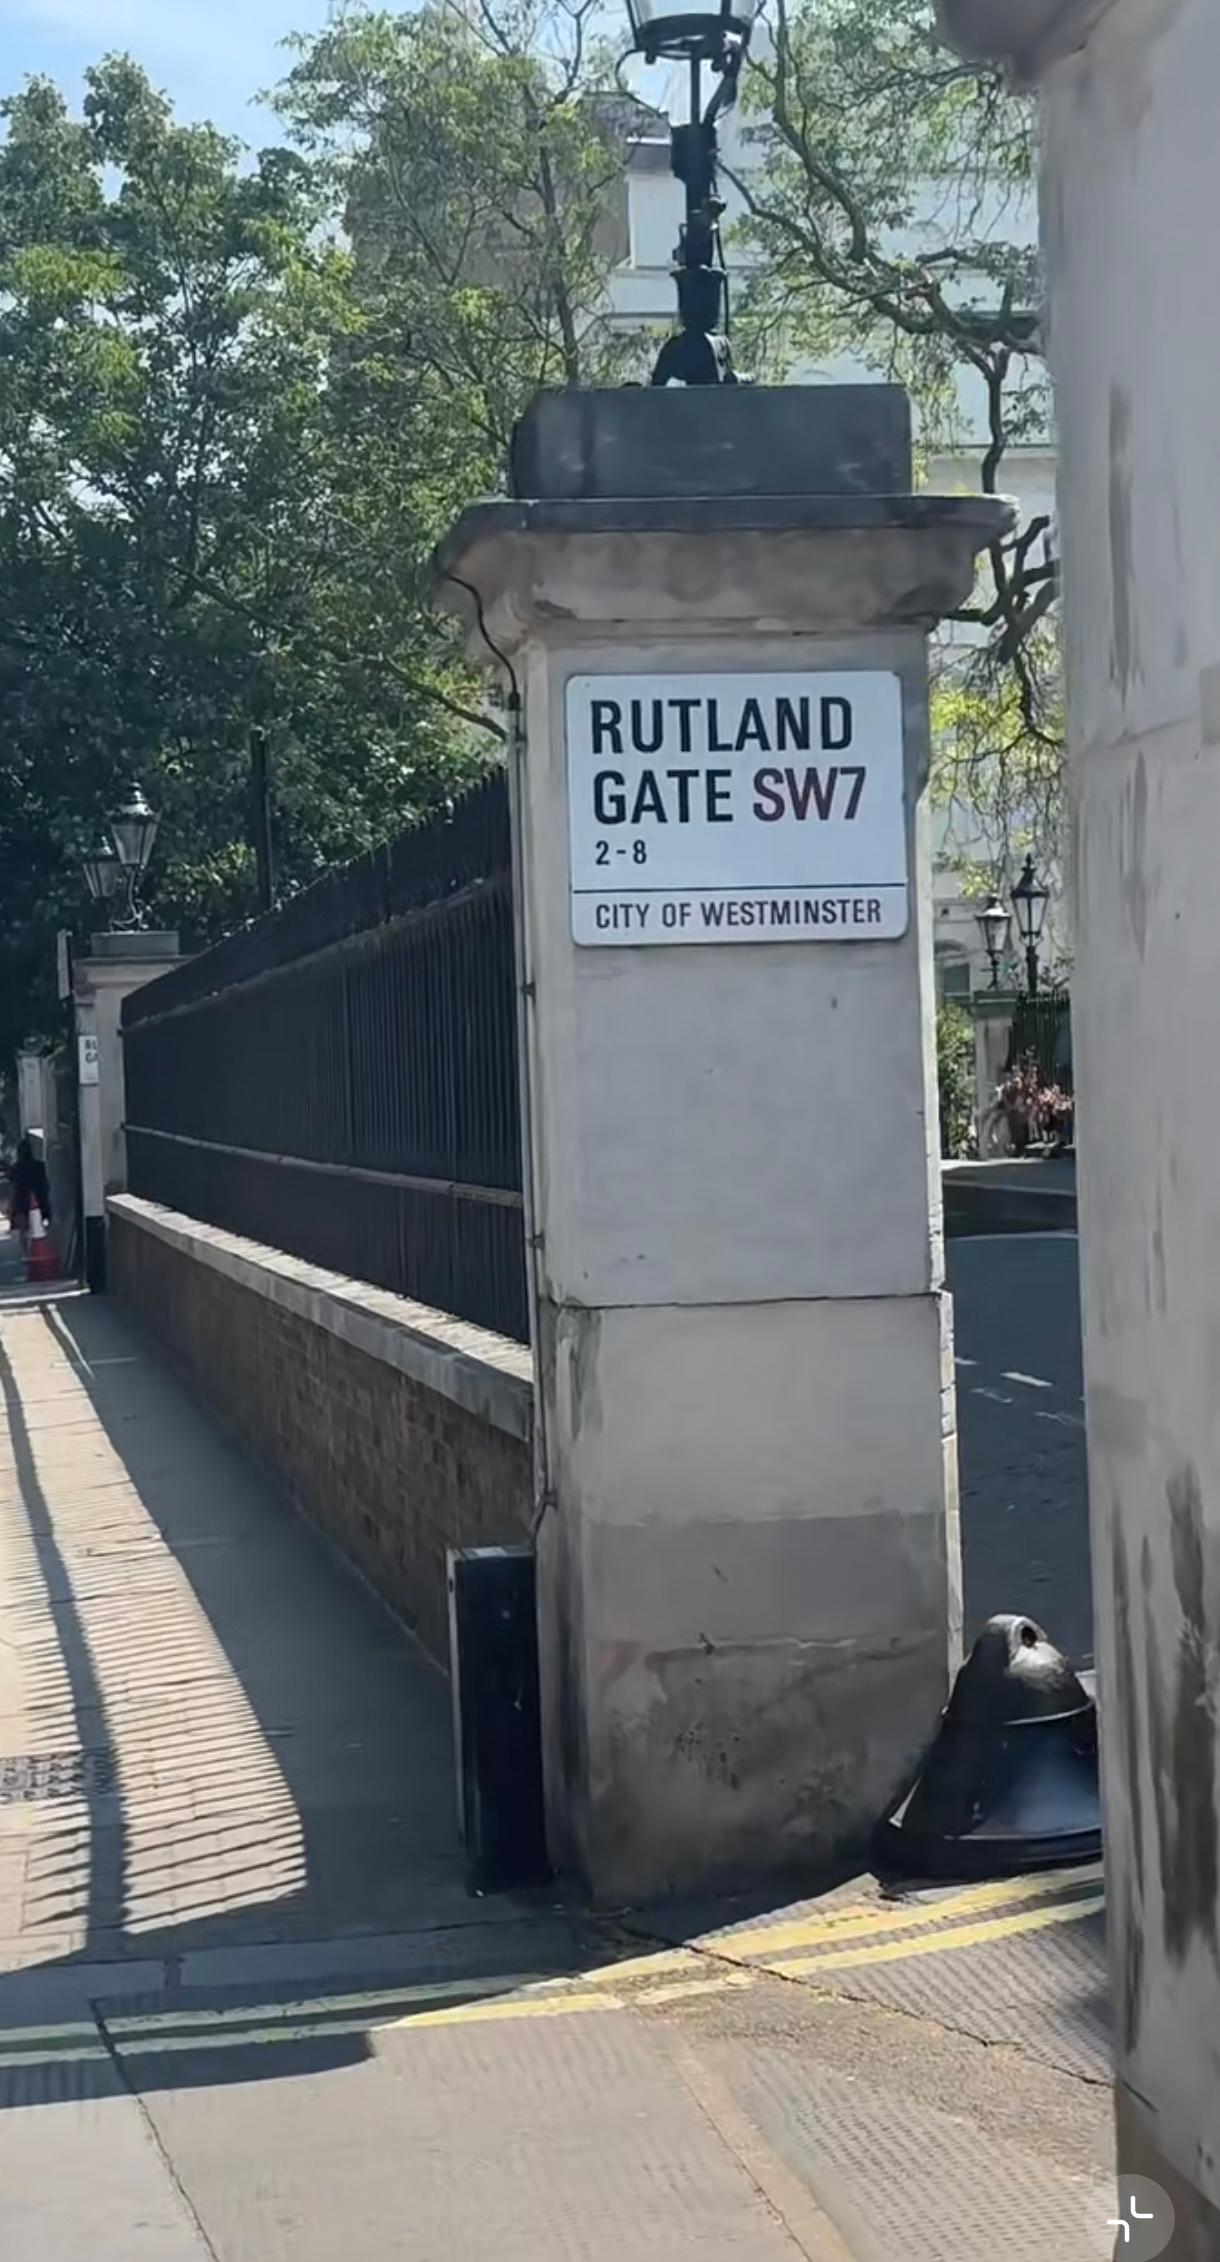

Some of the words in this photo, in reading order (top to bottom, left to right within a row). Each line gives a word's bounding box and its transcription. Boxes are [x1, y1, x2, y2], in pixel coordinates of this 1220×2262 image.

[591, 696, 852, 754] RUTLAND
[594, 768, 733, 825] GATE
[753, 766, 867, 822] SW7
[596, 903, 650, 928] CITY
[663, 903, 690, 927] OF
[701, 899, 881, 926] WESTMINSTER
